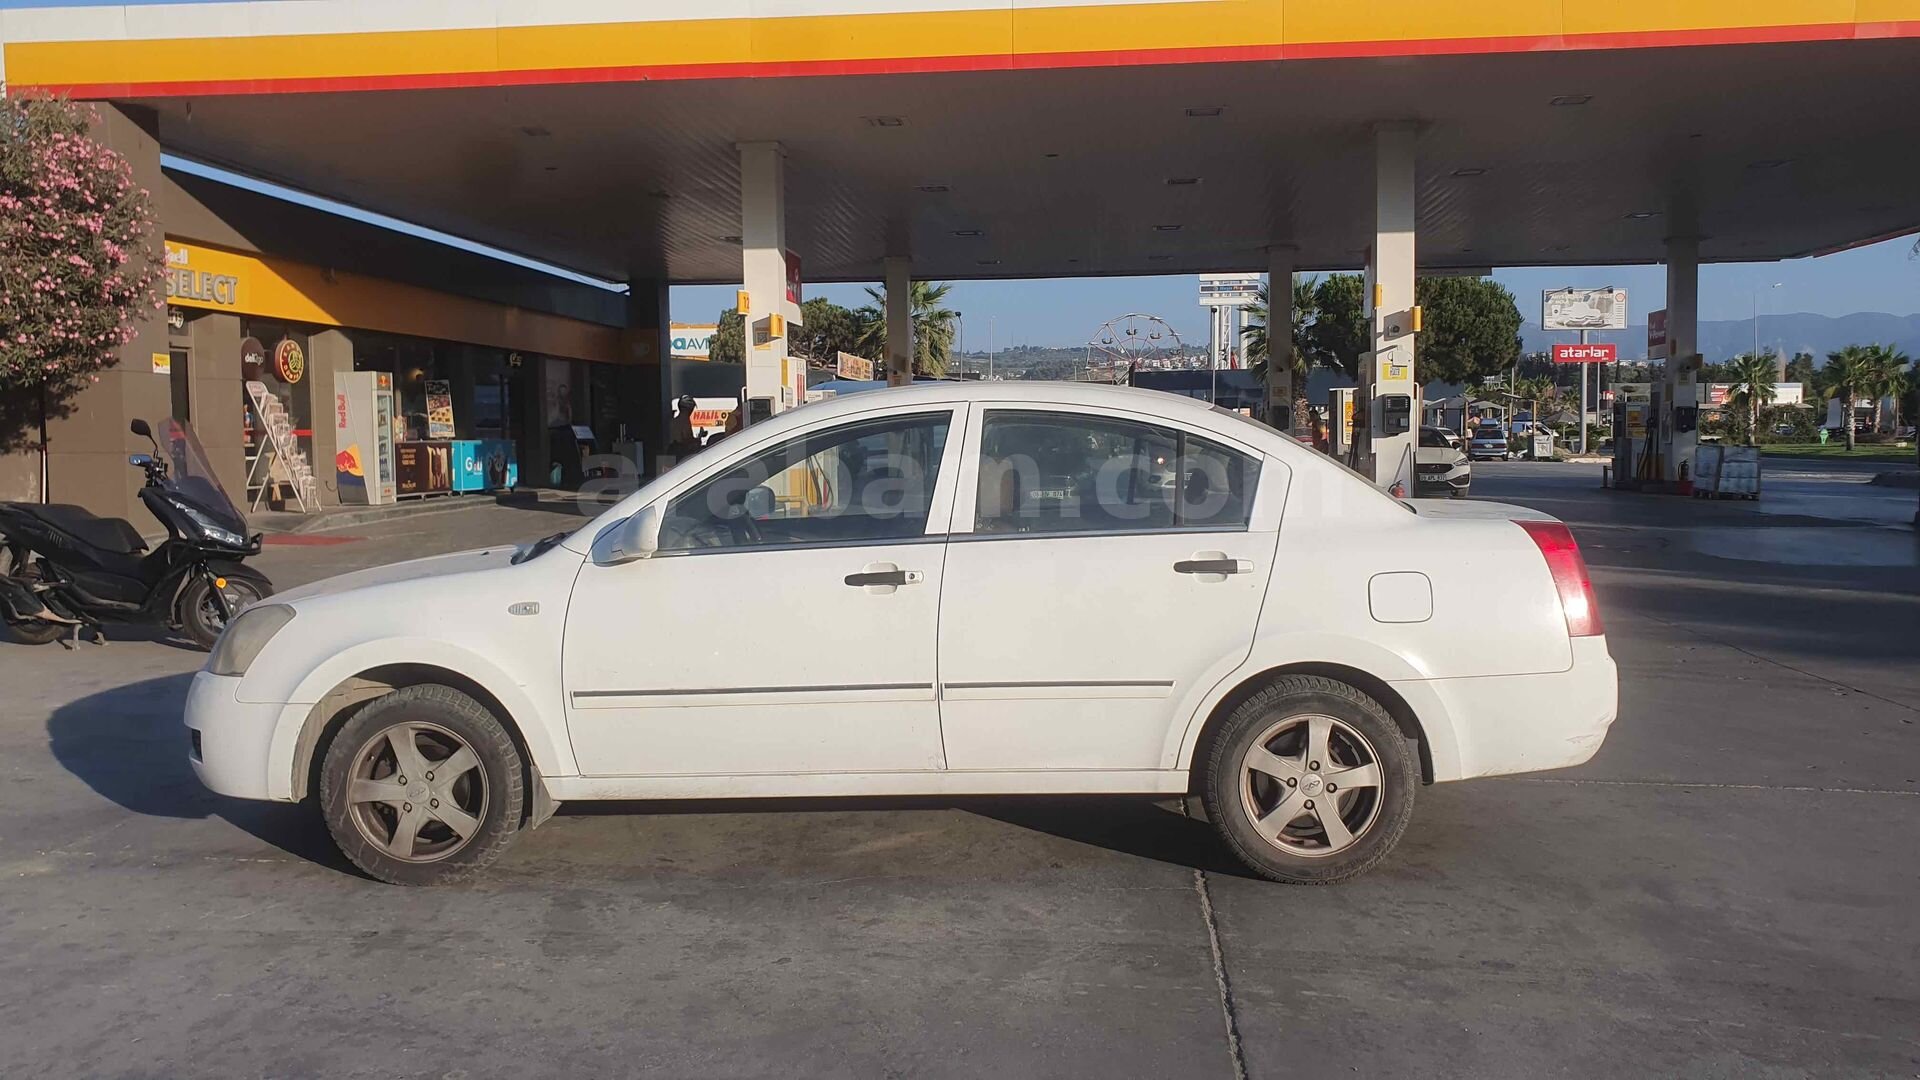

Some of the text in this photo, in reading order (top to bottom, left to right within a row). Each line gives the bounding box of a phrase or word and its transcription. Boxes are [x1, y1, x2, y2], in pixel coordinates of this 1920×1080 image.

[167, 269, 238, 305] SELECT
[1559, 346, 1609, 358] atarlar
[337, 394, 346, 429] Red Bull
